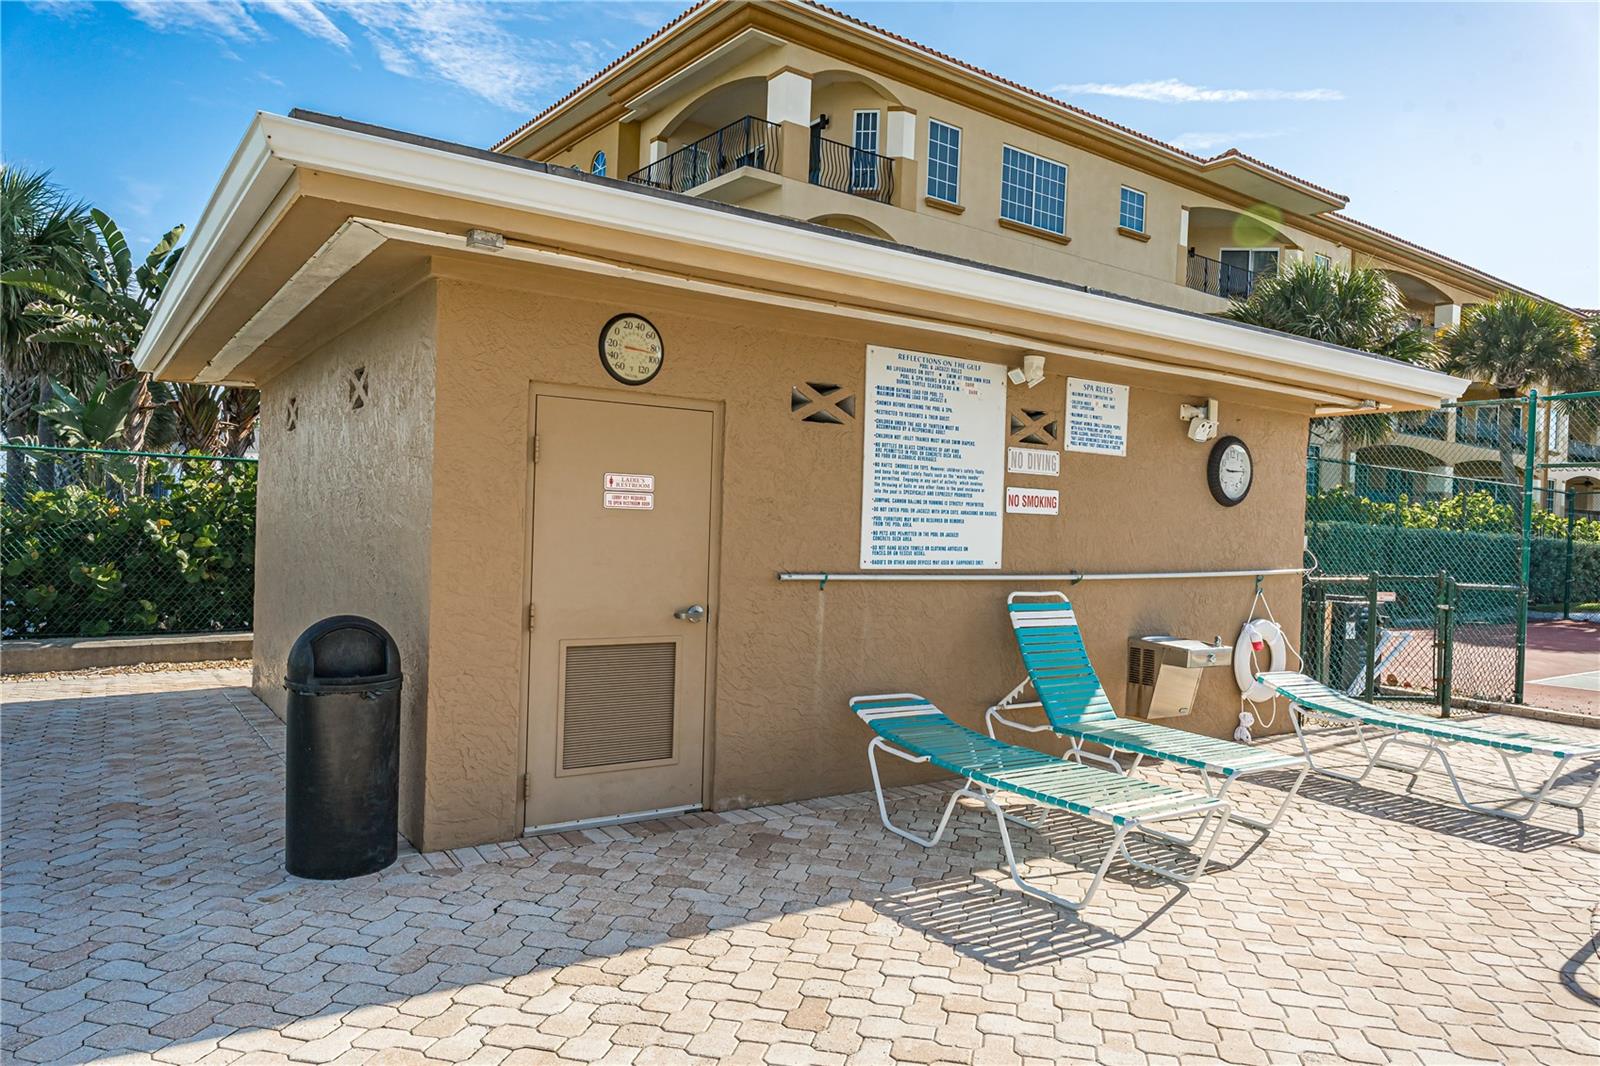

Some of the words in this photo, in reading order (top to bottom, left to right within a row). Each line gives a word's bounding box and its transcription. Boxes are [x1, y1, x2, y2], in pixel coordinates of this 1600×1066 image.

[623, 321, 633, 329] 20
[646, 331, 656, 340] 60
[898, 354, 941, 366] REFLECTIONS
[638, 366, 650, 374] 120
[1096, 385, 1114, 394] RULES
[1011, 451, 1023, 469] NO
[1028, 453, 1056, 472] DIVING
[1008, 494, 1019, 507] NO
[1022, 495, 1057, 508] SMOKING
